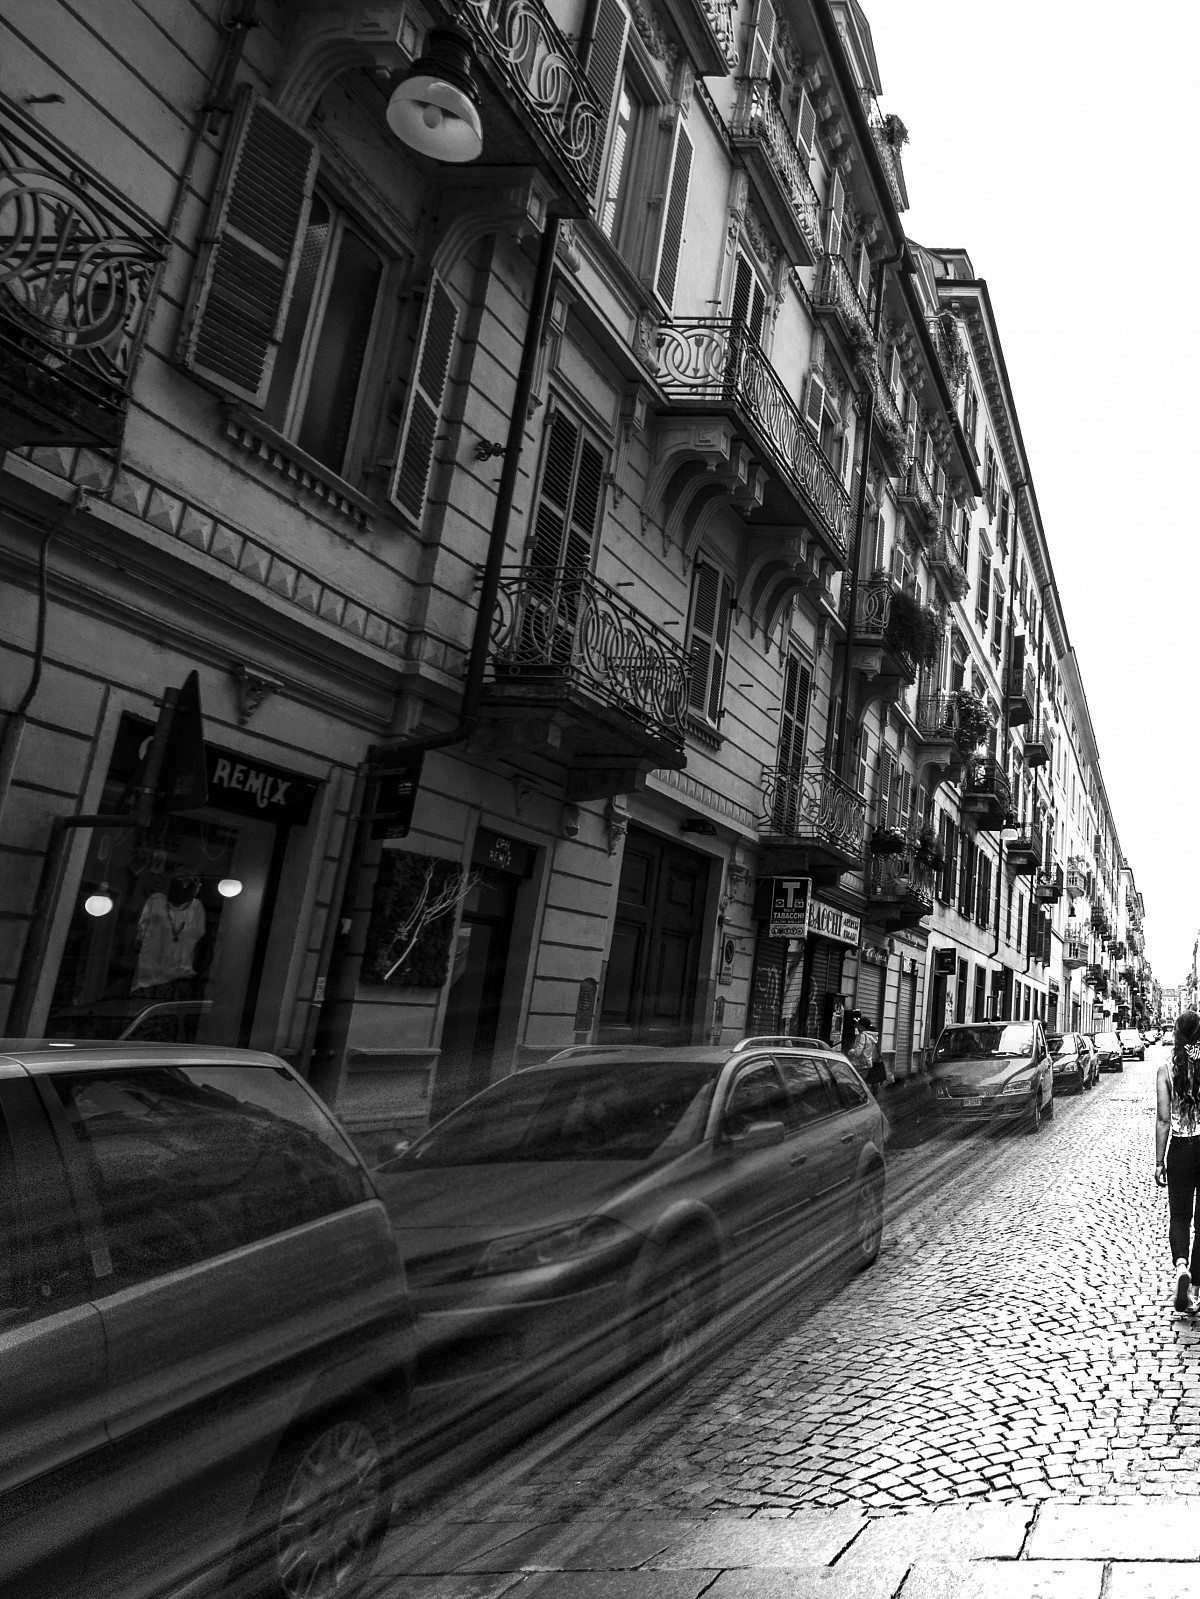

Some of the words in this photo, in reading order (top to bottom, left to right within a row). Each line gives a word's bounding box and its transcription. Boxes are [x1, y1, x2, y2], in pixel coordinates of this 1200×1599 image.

[212, 757, 291, 808] REMIX
[489, 850, 512, 869] REMIX
[782, 882, 801, 908] T
[773, 912, 805, 920] TABACCHI
